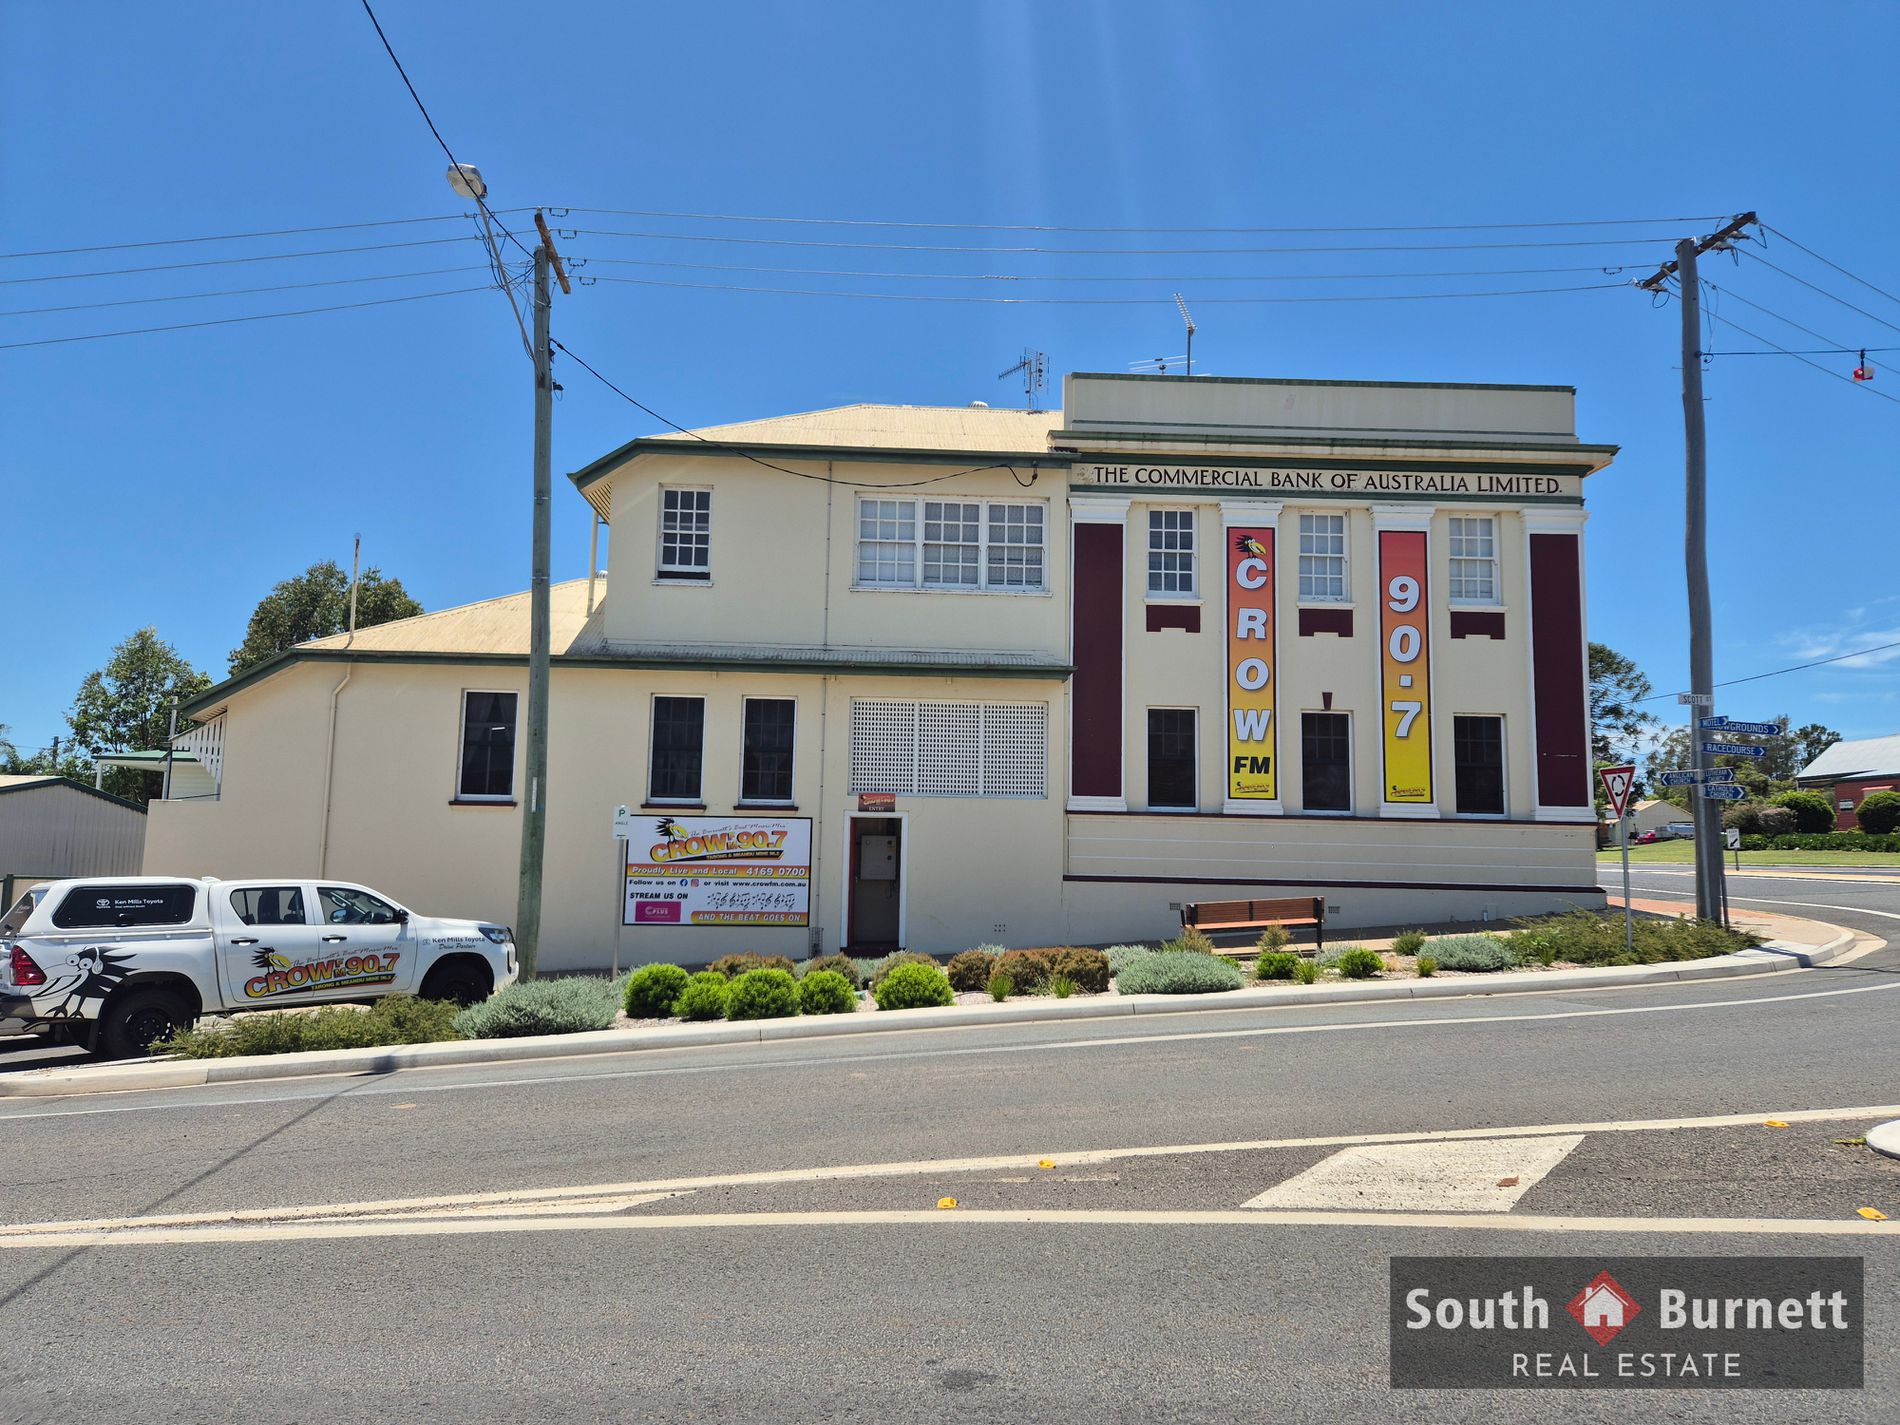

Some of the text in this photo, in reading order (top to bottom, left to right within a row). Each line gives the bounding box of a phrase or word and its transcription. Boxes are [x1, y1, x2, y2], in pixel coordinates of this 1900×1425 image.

[1094, 467, 1563, 494] THE COMMERCIAL BANK OF AUSTRALIA LIMITED.
[1233, 557, 1272, 742] CROW
[1388, 575, 1422, 738] 90.7
[1683, 695, 1703, 704] SCOTT
[1702, 718, 1721, 727] MOTEL
[1713, 722, 1769, 733] WGROUNDS
[1707, 743, 1756, 755] RACECOURSE
[1234, 756, 1270, 774] FM
[619, 809, 626, 817] P
[650, 834, 726, 862] CROW
[737, 830, 788, 849] 90.7
[632, 866, 666, 875] Proudly
[746, 868, 773, 876] 4169
[779, 868, 806, 876] 0700
[699, 913, 716, 921] AND
[720, 913, 735, 921] THE
[738, 913, 759, 921] BEAT
[244, 959, 334, 998] CROW
[345, 952, 400, 975] 90.7
